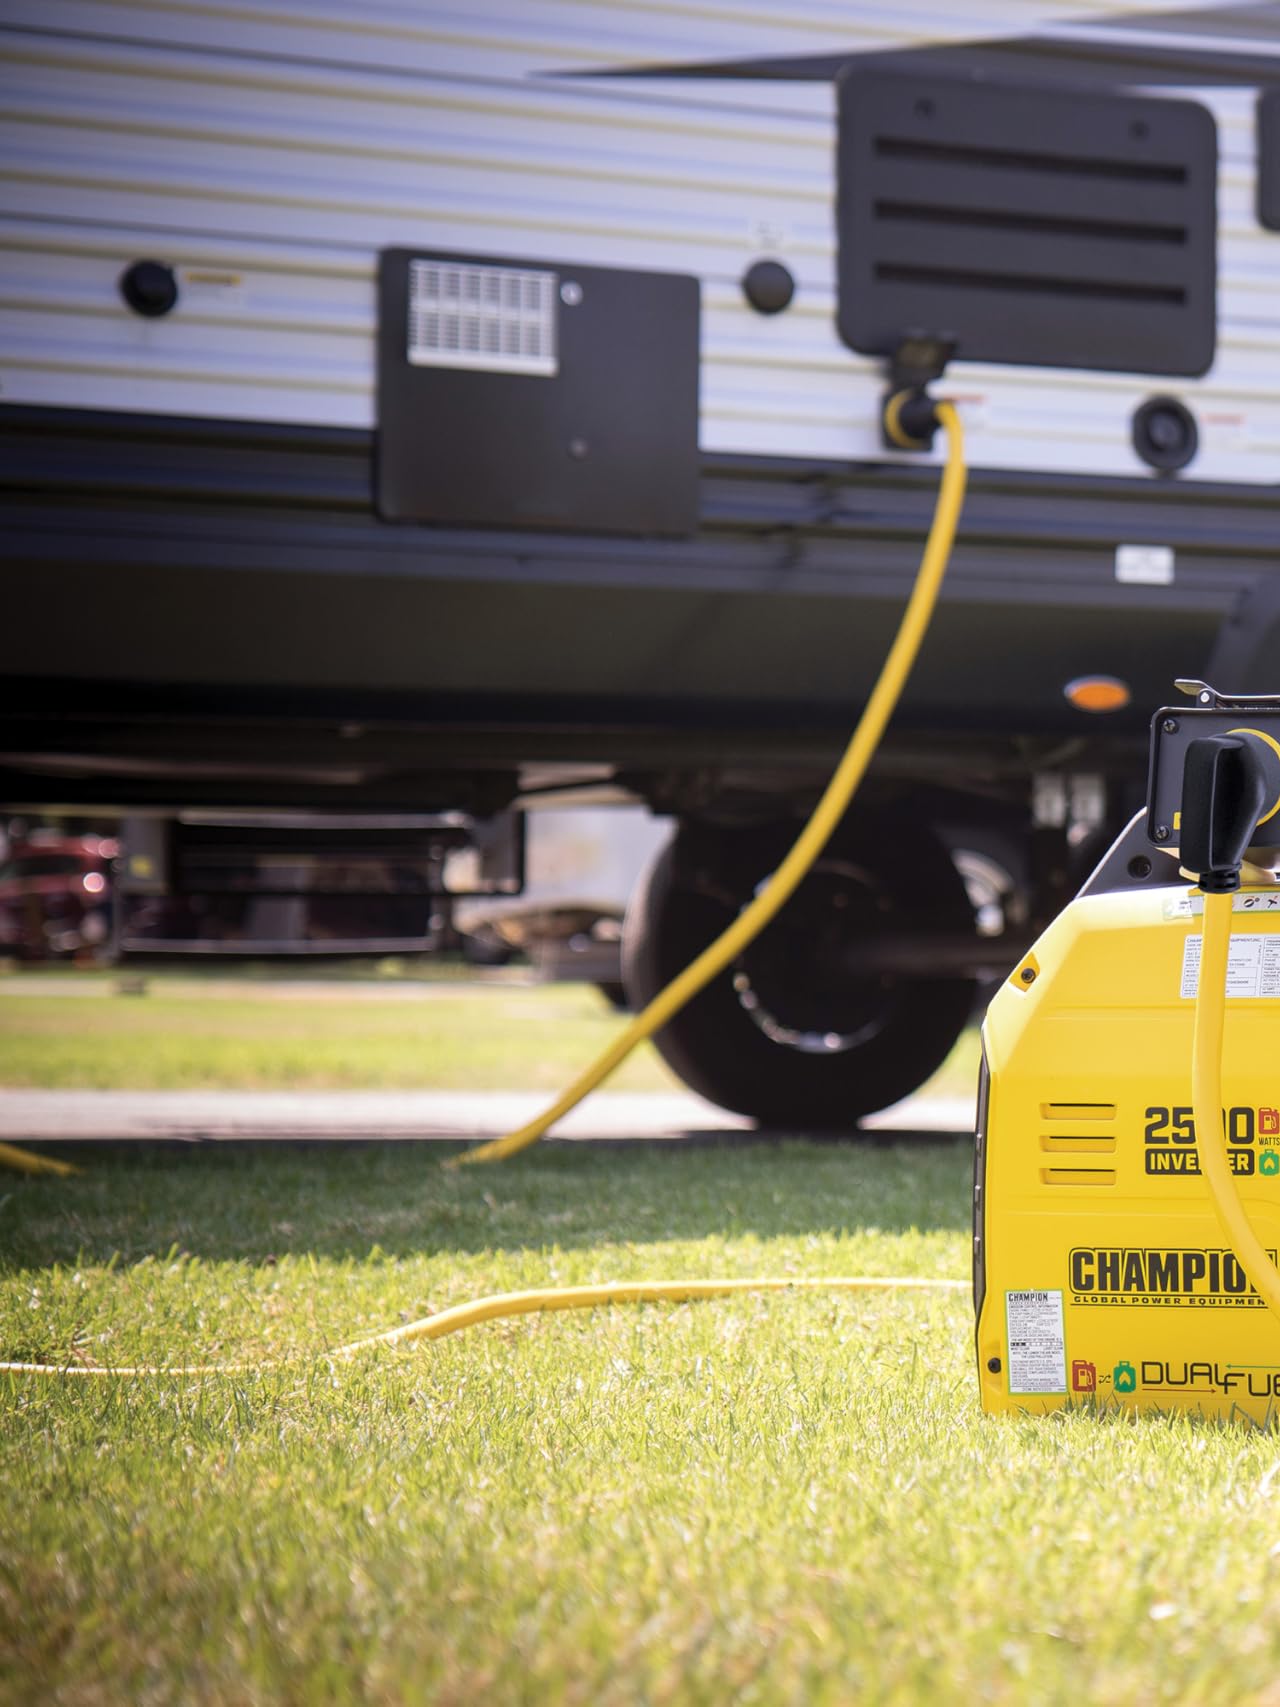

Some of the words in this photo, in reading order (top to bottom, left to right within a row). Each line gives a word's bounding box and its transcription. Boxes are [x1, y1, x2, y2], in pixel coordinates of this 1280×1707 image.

[1144, 1106, 1255, 1145] 250
[1258, 1137, 1280, 1146] WATTS
[1149, 1152, 1250, 1172] INVEER
[1072, 1251, 1274, 1294] CHAMPIO
[1008, 1292, 1049, 1302] CHAMPION
[1074, 1295, 1127, 1304] GLOBAL
[1131, 1297, 1182, 1305] POWER
[1188, 1297, 1266, 1306] EQUIPMEN
[1141, 1361, 1237, 1386] DUAL
